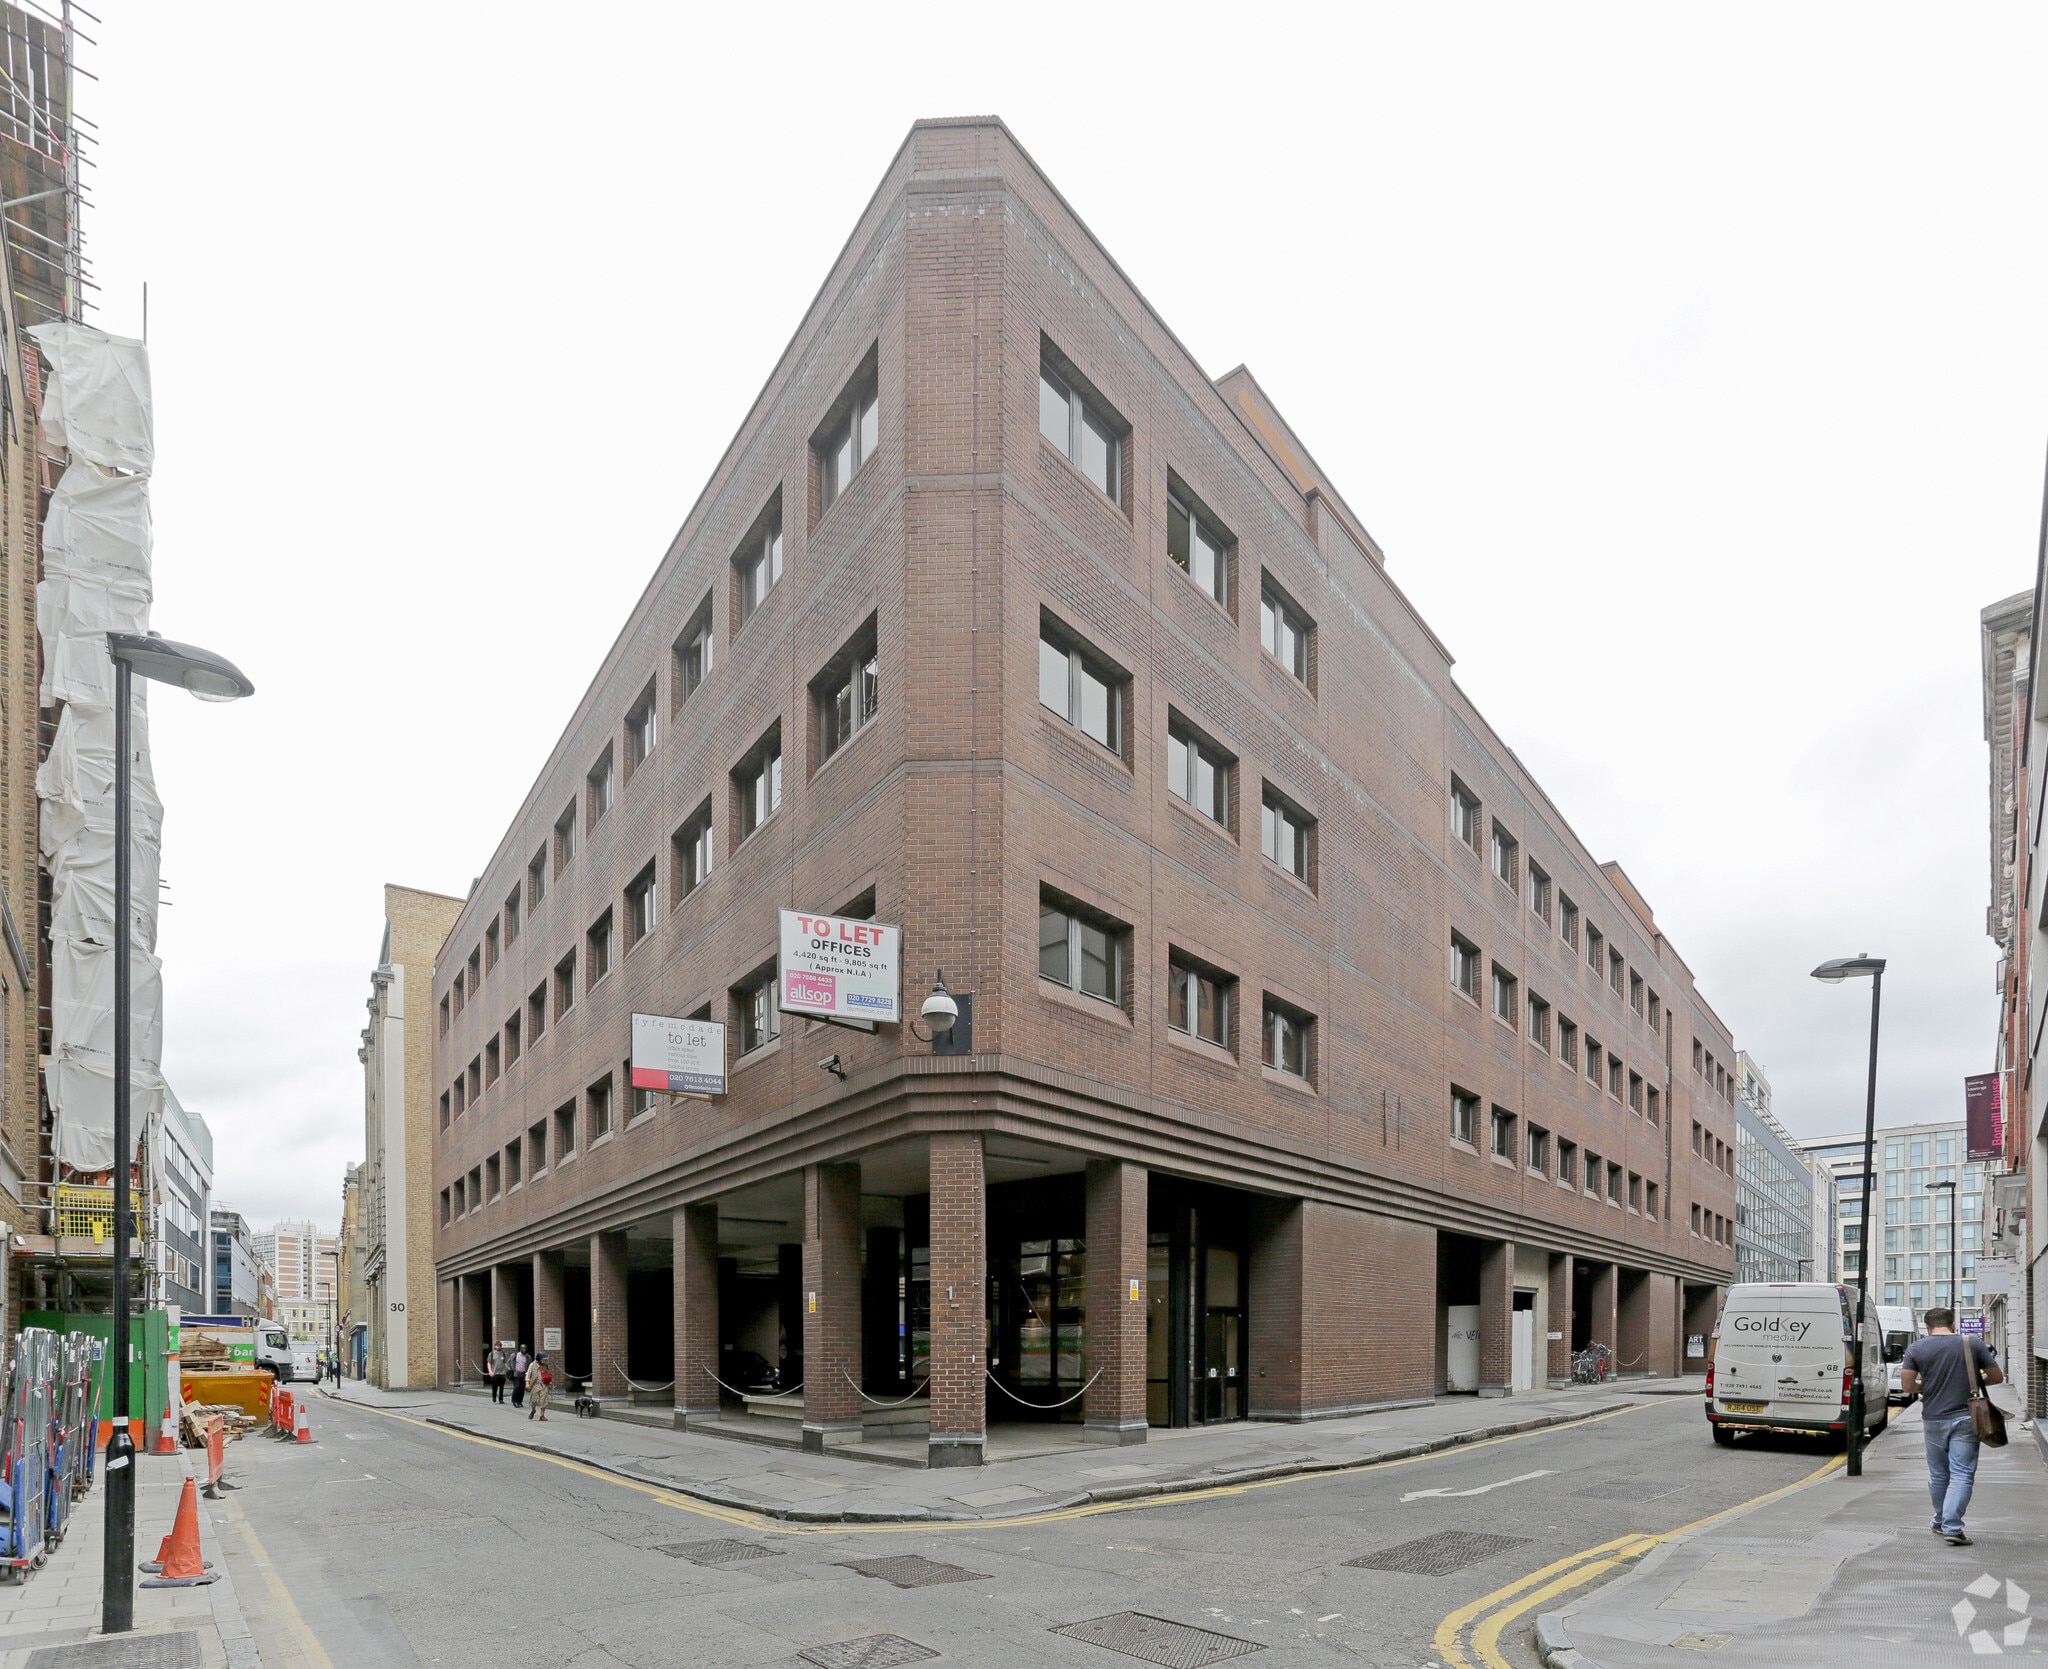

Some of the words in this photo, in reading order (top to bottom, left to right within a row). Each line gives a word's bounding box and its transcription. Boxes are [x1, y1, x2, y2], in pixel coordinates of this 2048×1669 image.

[797, 916, 831, 938] TO
[839, 923, 884, 946] LET
[811, 939, 871, 958] OFFICES
[793, 950, 817, 960] 4,420
[820, 955, 829, 963] sq
[844, 958, 867, 968] 9,805
[869, 963, 879, 971] sq
[789, 983, 832, 1006] allsop
[668, 1031, 683, 1045] to
[687, 1033, 707, 1047] let
[669, 1074, 684, 1082] 020
[684, 1075, 703, 1084] 7613
[703, 1077, 722, 1085] 4044
[1991, 1078, 2001, 1110] House
[1991, 1112, 2003, 1146] Bonhill
[390, 1302, 405, 1312] 30
[1762, 1332, 1796, 1342] media
[1826, 1364, 1839, 1372] GB
[1727, 1403, 1746, 1412] RJ64
[1746, 1405, 1761, 1413] USE
